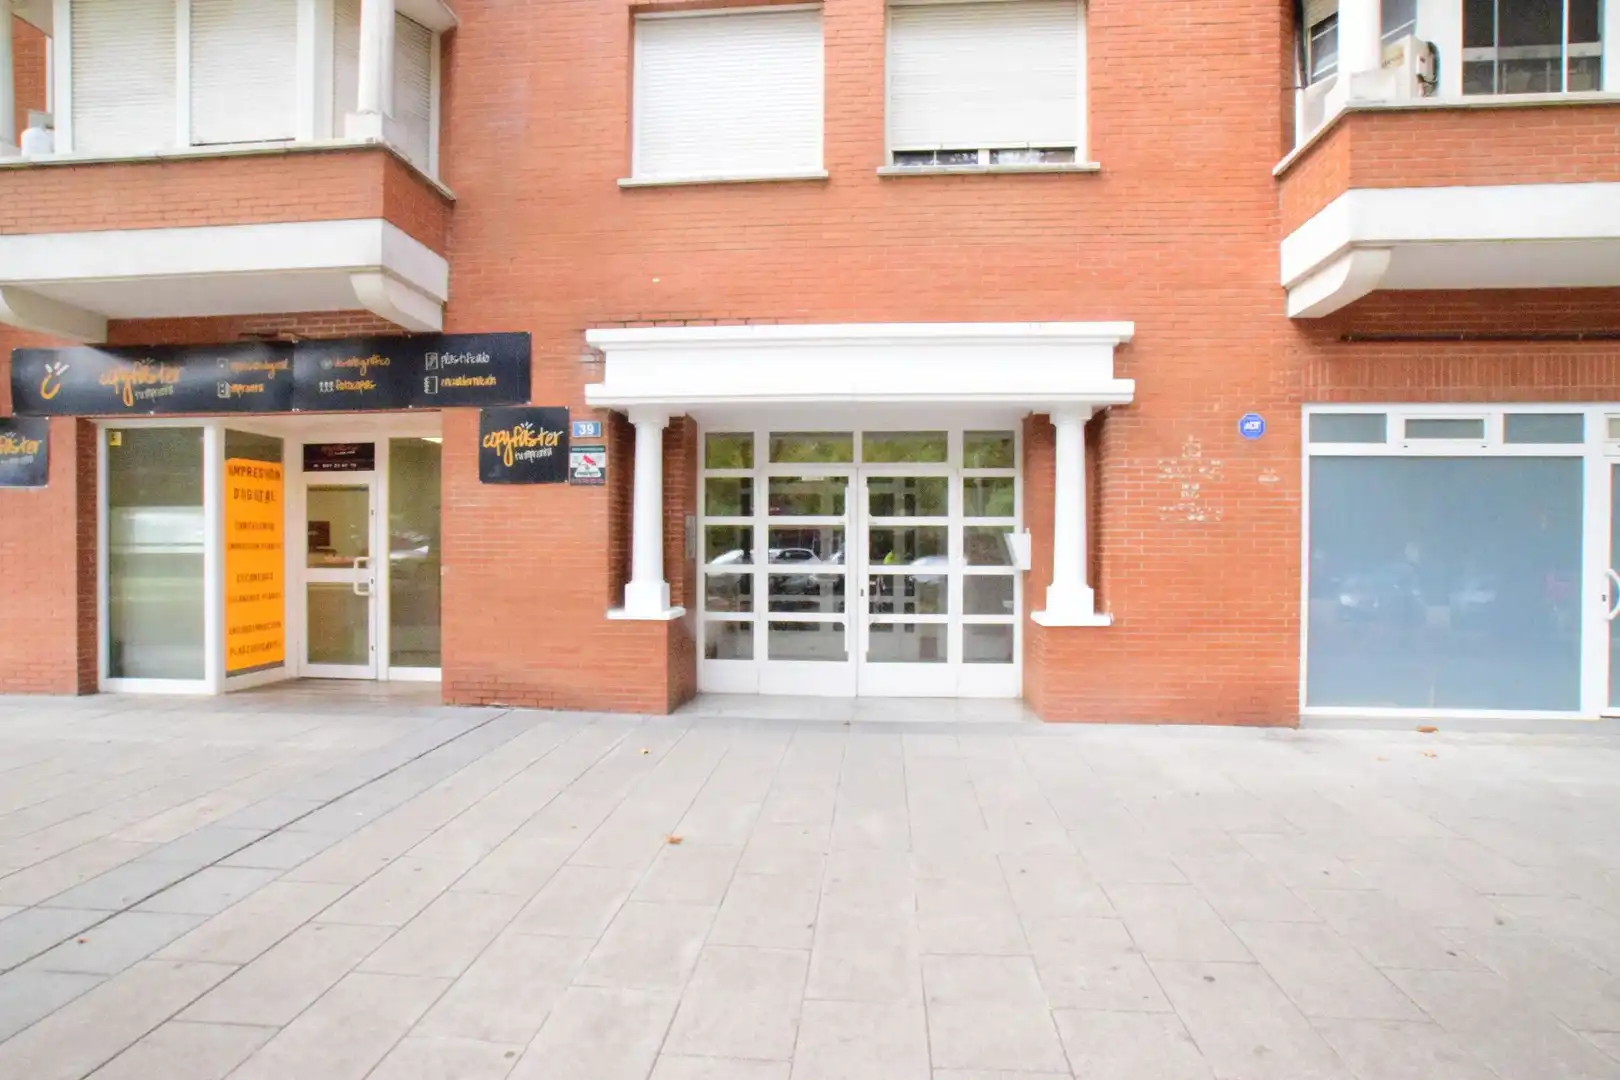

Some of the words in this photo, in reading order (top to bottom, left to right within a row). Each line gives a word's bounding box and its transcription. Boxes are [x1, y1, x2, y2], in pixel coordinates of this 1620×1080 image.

[579, 423, 595, 436] 39
[483, 425, 564, 467] copyfaster
[233, 487, 277, 504] DIGITAL
